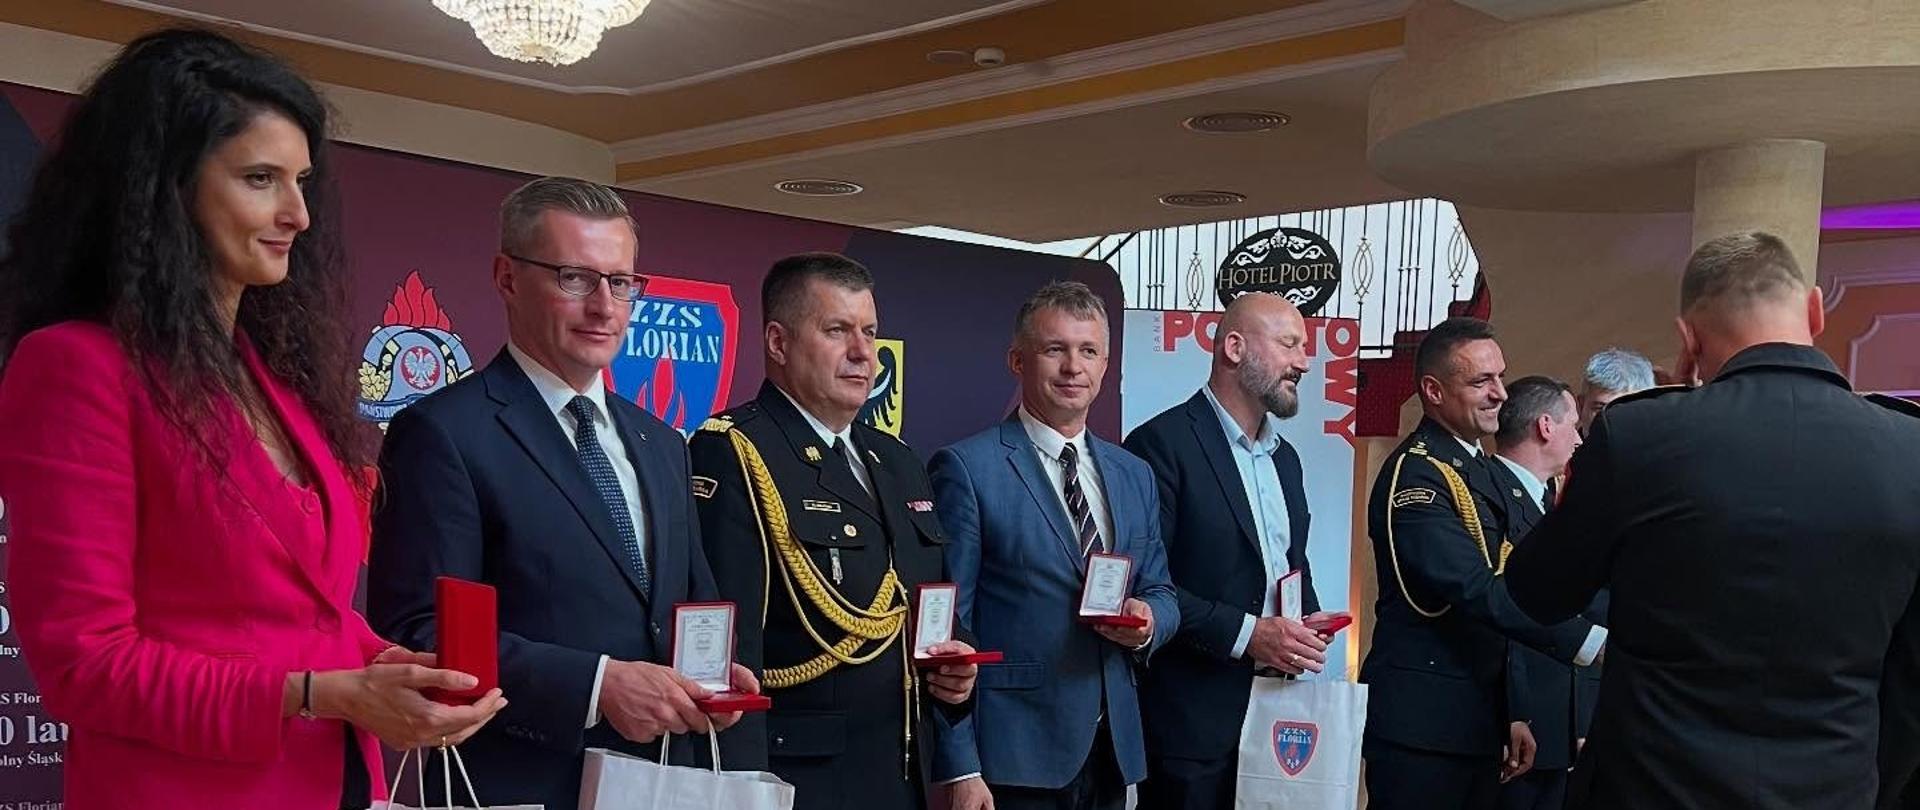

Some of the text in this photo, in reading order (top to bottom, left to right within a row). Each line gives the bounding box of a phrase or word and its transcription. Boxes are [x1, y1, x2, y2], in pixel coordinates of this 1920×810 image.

[1219, 262, 1336, 289] HOTEL PIOTR
[628, 300, 703, 328] ZZS
[626, 326, 720, 364] LORIAN
[28, 750, 63, 767] Śląsk
